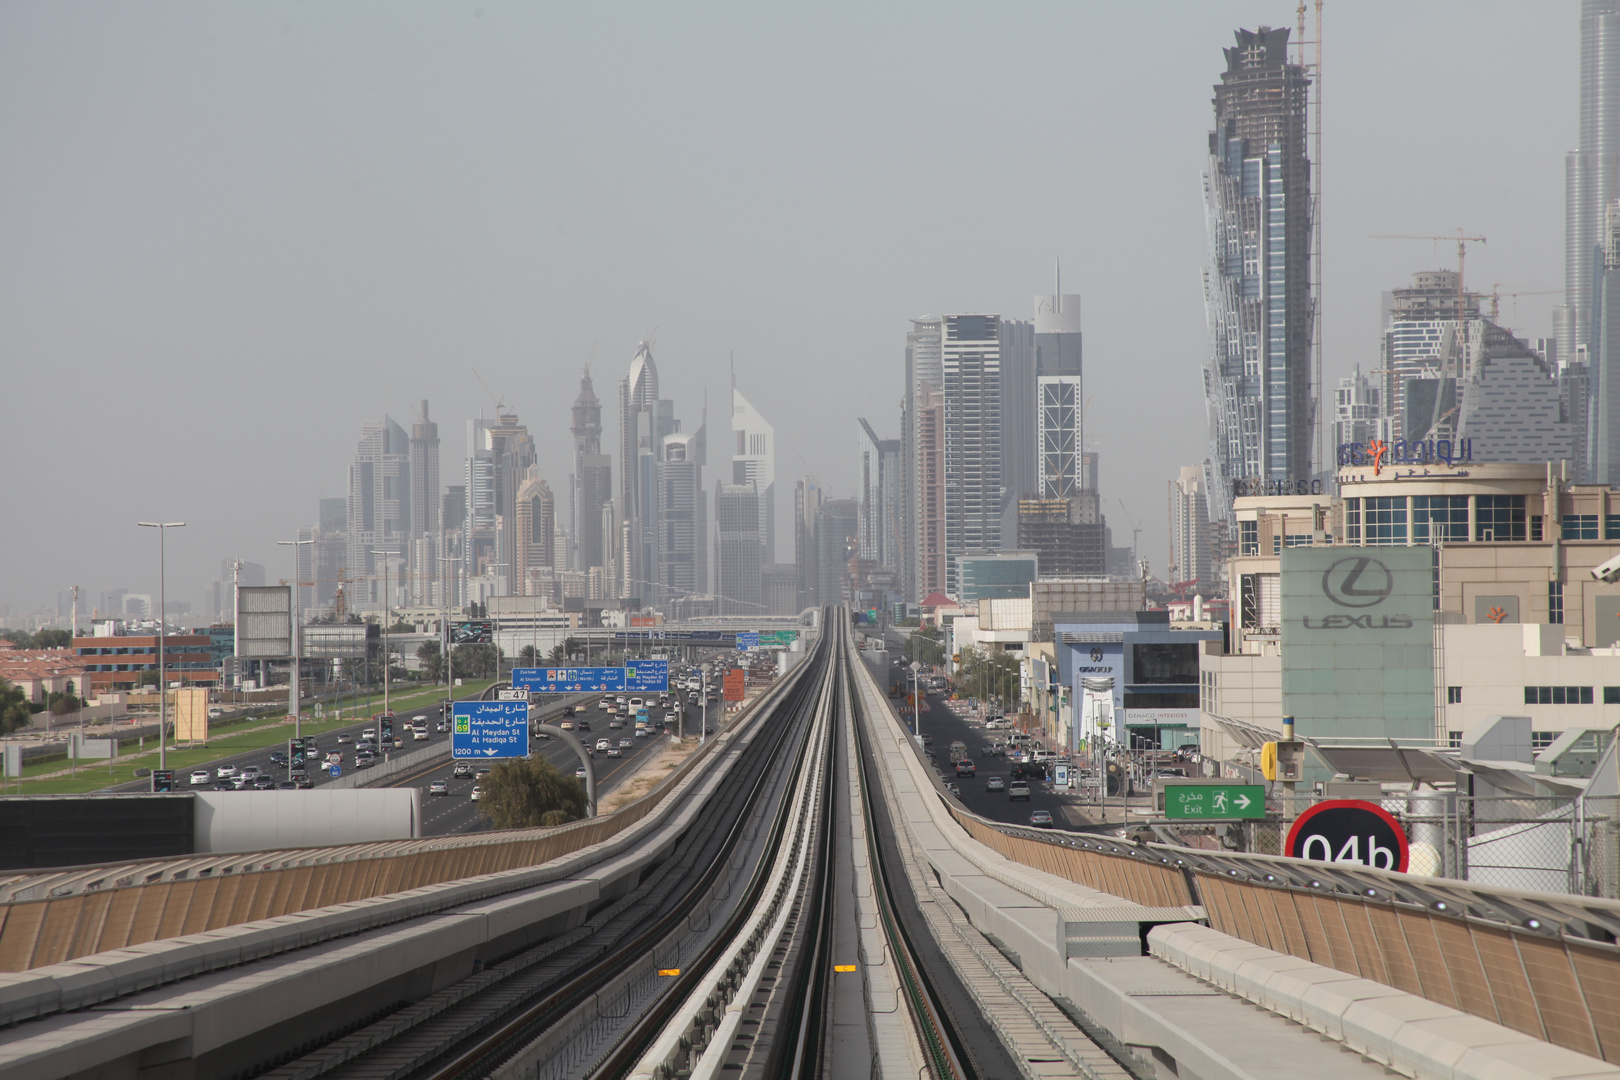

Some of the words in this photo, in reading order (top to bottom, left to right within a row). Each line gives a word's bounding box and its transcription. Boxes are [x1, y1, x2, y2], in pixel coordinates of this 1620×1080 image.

[1394, 437, 1472, 467] الواحة
[1303, 613, 1413, 630] LEXUS
[513, 691, 525, 699] 47
[476, 704, 503, 714] الميدان
[505, 704, 526, 714] شارع
[472, 717, 504, 726] الحديقة
[505, 717, 526, 727] شارع
[457, 724, 468, 732] 69
[482, 729, 510, 737] Meydan
[1179, 792, 1203, 802] مخرج
[1184, 804, 1203, 814] Exit
[1302, 834, 1394, 870] 04b
